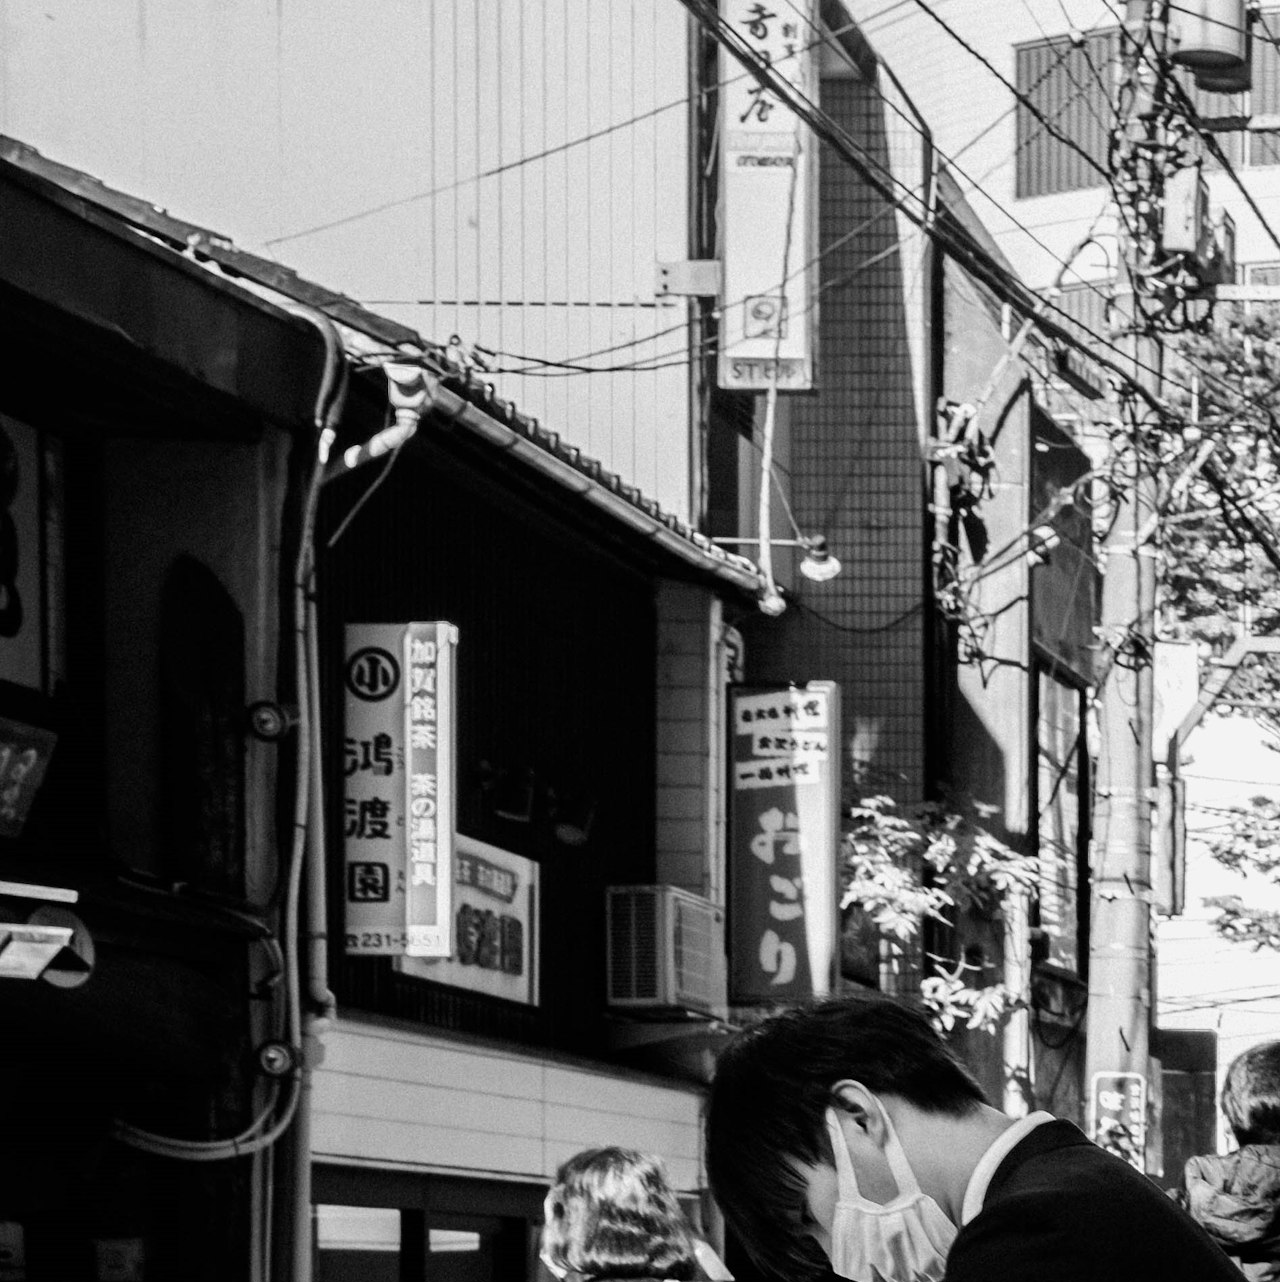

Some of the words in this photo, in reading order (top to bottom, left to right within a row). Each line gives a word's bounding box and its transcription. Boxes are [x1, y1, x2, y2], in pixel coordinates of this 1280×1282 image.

[410, 638, 437, 749] 加賀銘茶
[344, 732, 392, 903] 鴻渡園
